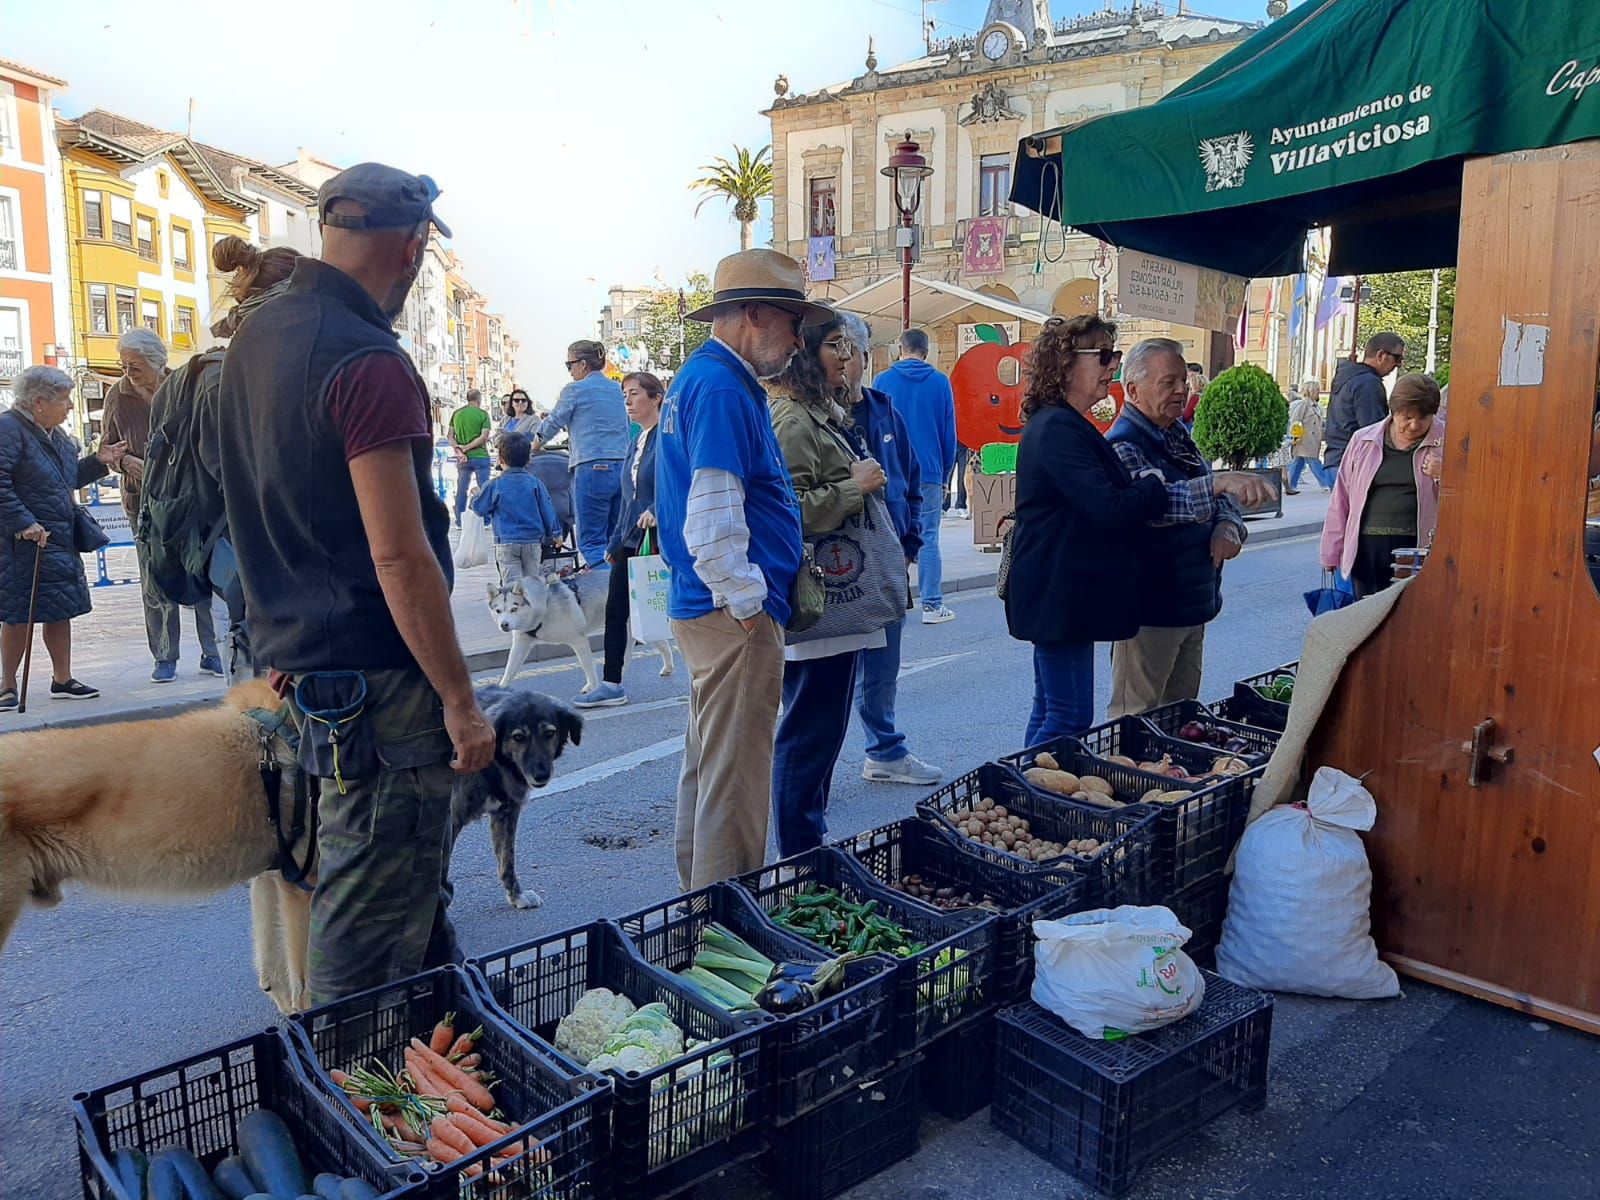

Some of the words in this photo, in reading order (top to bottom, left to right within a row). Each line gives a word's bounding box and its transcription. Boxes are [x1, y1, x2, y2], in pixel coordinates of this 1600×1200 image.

[1269, 92, 1403, 146] Ayuntamiento
[1408, 83, 1433, 104] de
[1269, 114, 1431, 175] Villaviciosa
